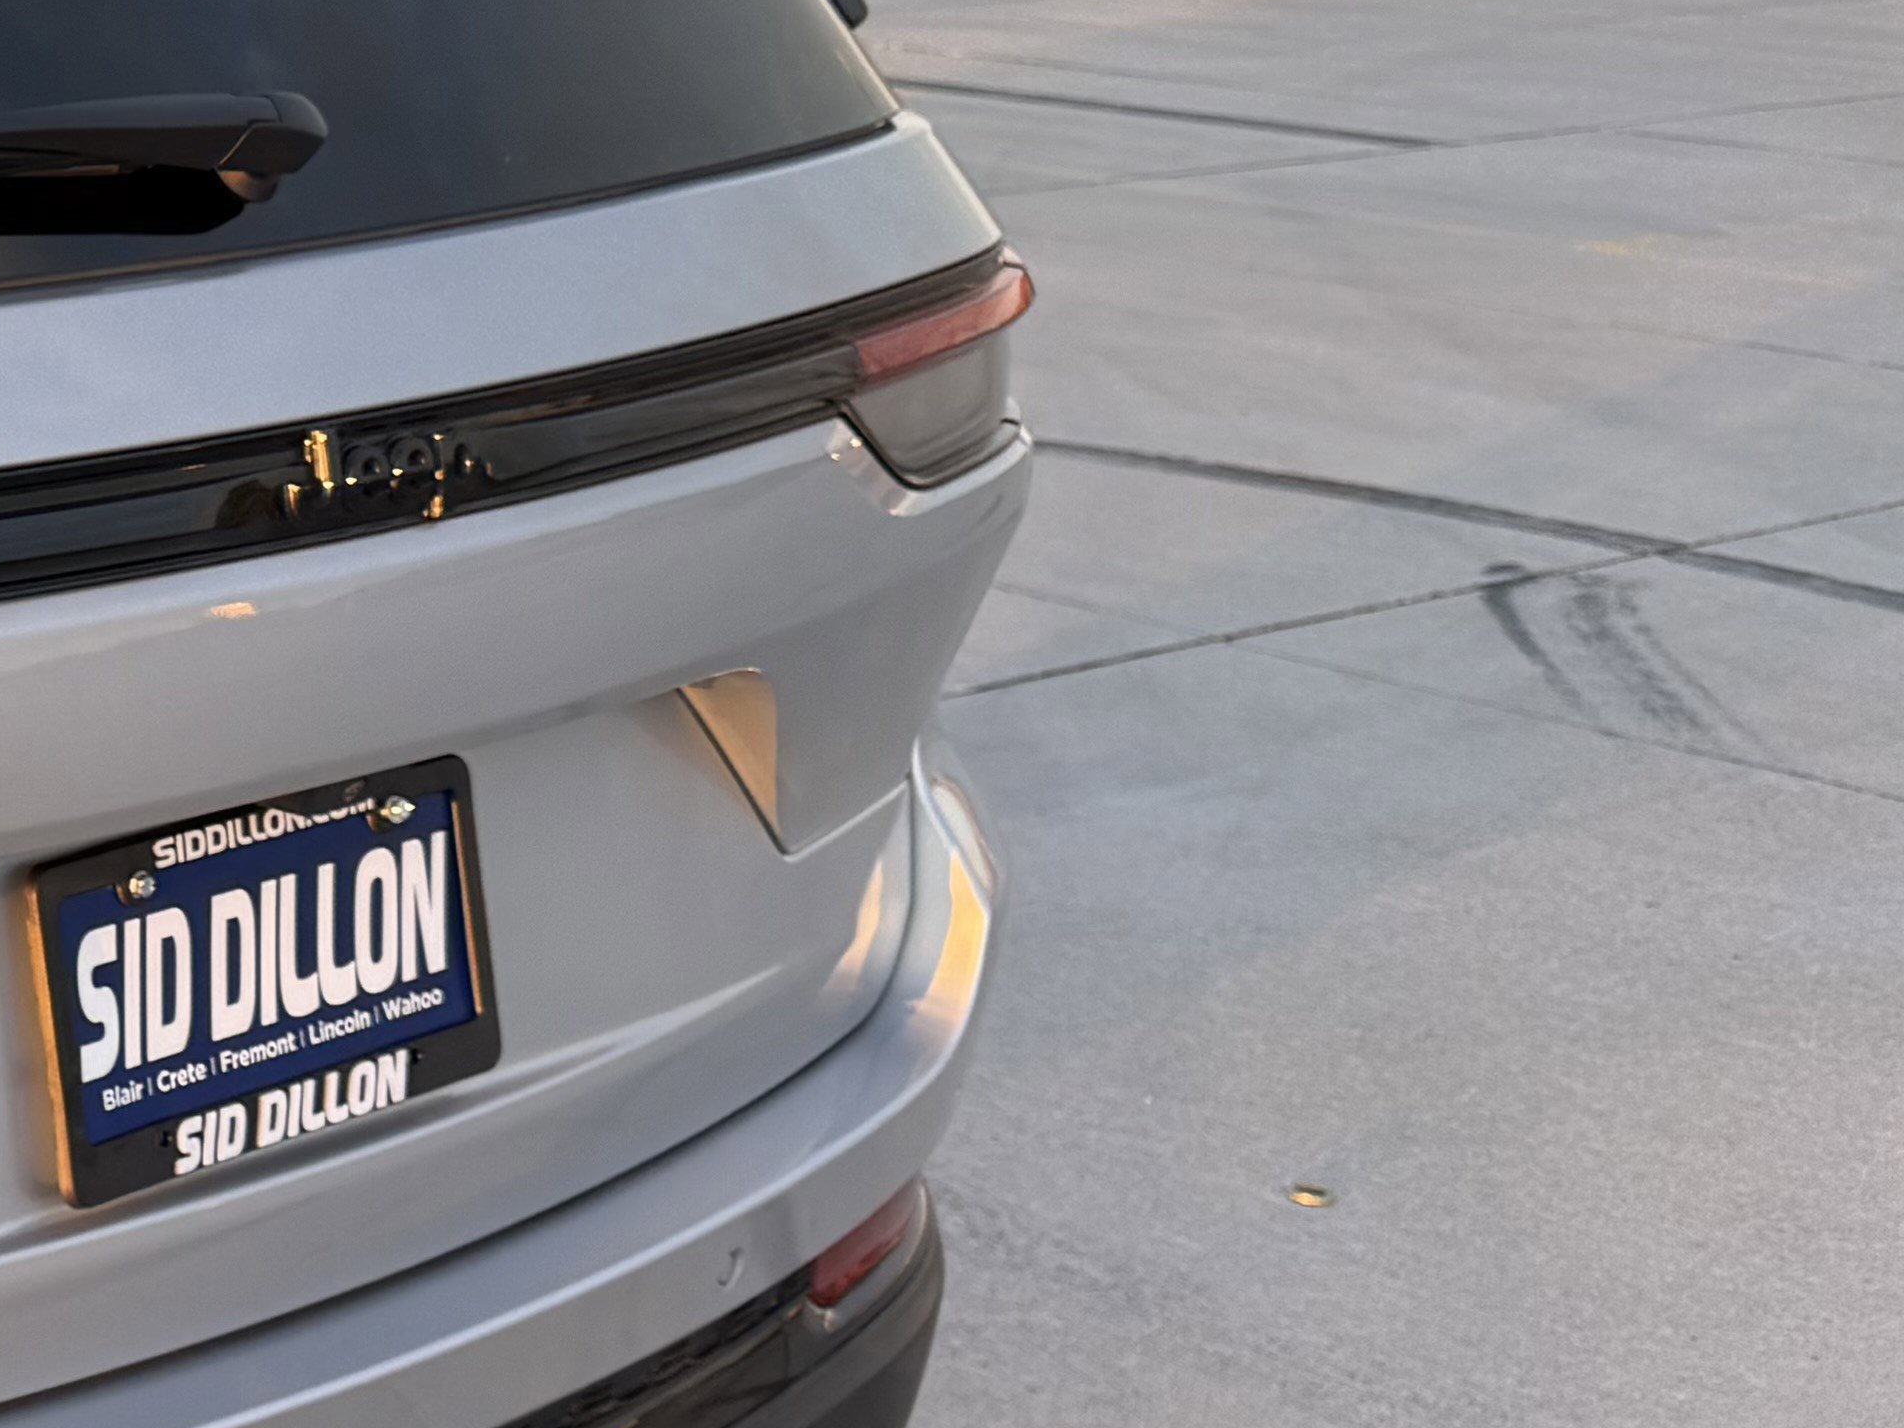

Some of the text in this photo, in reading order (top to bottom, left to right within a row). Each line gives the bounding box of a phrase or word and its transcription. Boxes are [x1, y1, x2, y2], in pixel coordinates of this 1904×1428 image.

[76, 830, 447, 1084] SID DILLON
[101, 987, 444, 1112] Blair Crete Fremont Lincoln Wahoo
[174, 1048, 409, 1176] SID DILLON
